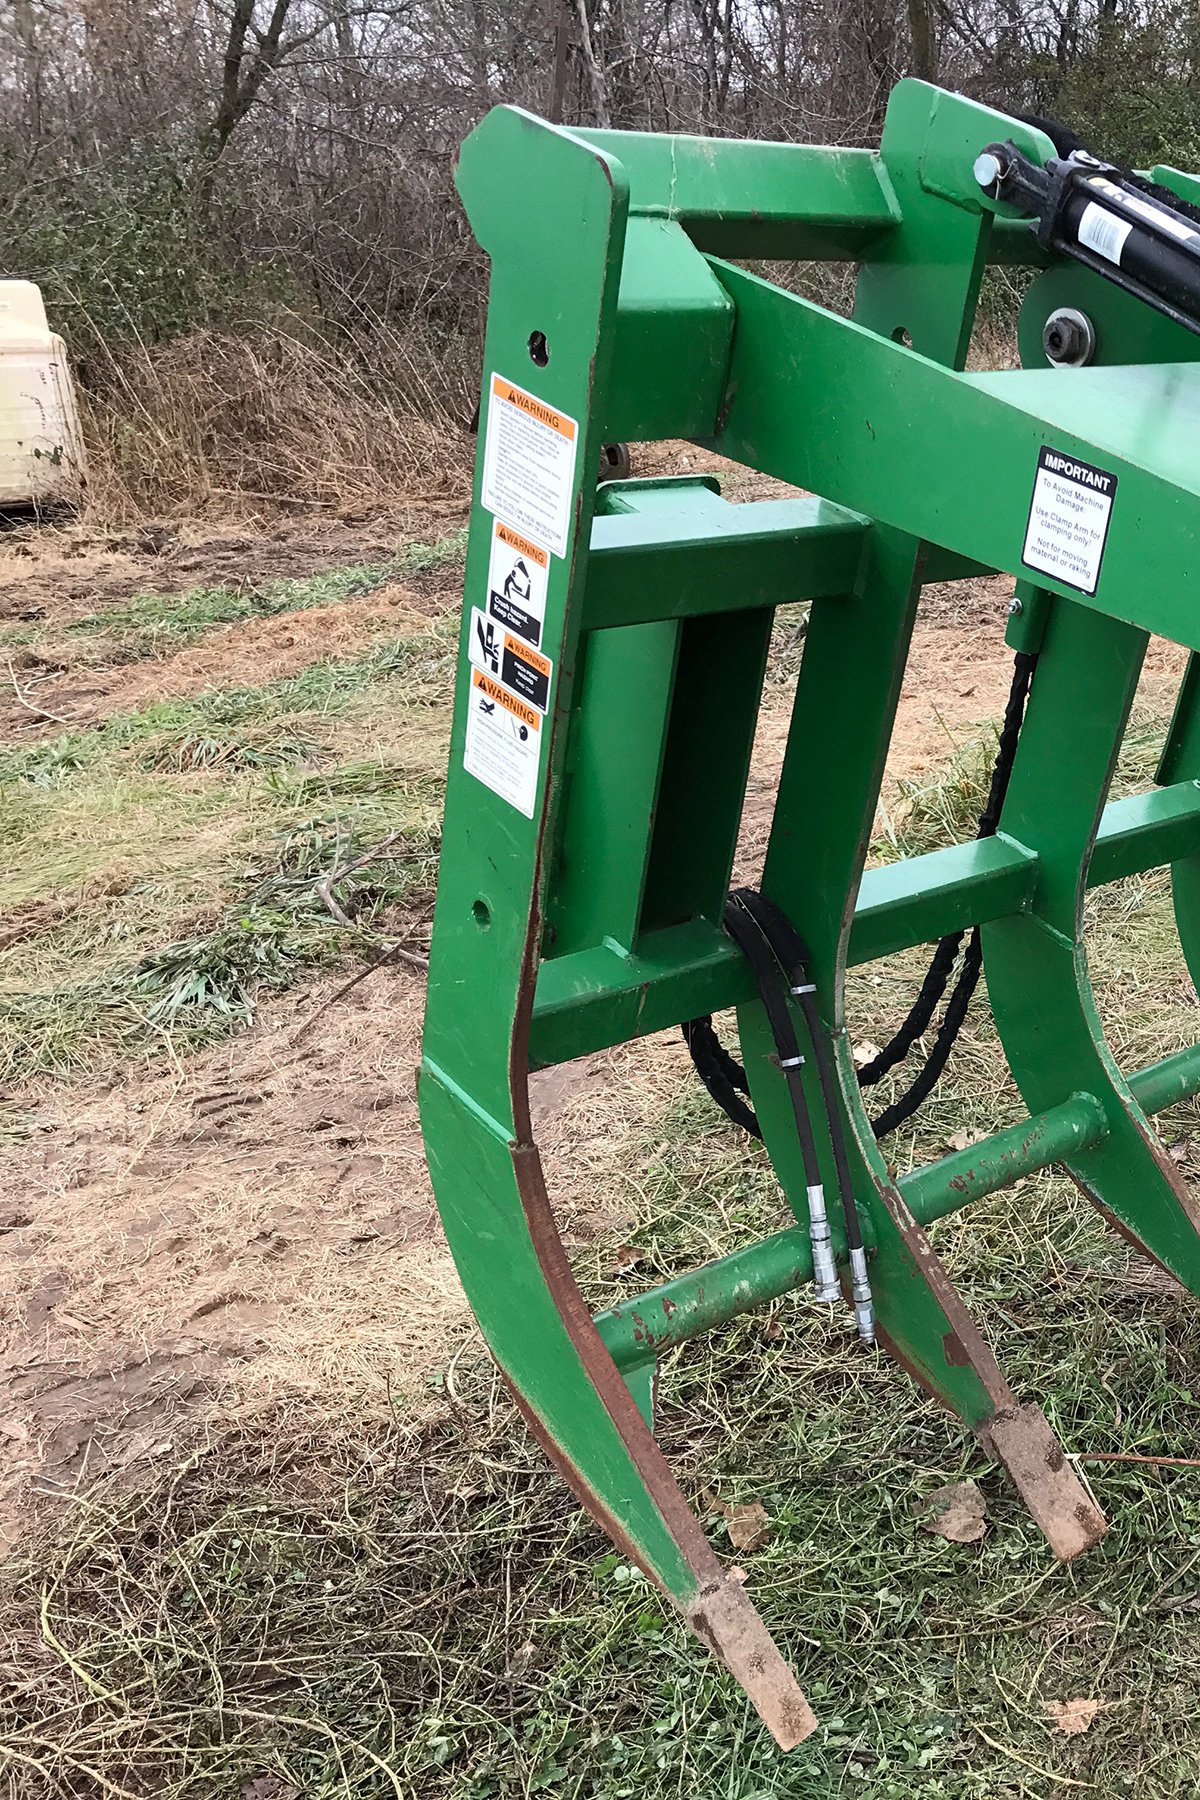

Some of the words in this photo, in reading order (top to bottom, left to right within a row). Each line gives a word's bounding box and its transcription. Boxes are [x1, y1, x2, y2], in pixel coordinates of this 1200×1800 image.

[515, 394, 559, 428] WARNING
[1044, 453, 1111, 492] IMPORTANT
[1042, 477, 1052, 488] To
[1052, 482, 1072, 498] Avoid
[1074, 491, 1104, 511] Machine
[1055, 494, 1086, 514] Damage:
[1035, 506, 1049, 518] Use
[1050, 512, 1072, 529] Clamp
[1073, 523, 1089, 535] Arm
[1090, 528, 1101, 540] for
[1040, 519, 1072, 541] clamping
[1073, 532, 1092, 548] only!
[506, 532, 544, 563] WARNING
[1030, 546, 1059, 563] material
[1060, 558, 1068, 567] or
[1068, 560, 1091, 580] raking
[1037, 537, 1050, 549] Not
[1050, 541, 1061, 553] for
[1062, 549, 1088, 568] moving
[513, 643, 546, 671] WARNING
[486, 681, 535, 725] WARNING
